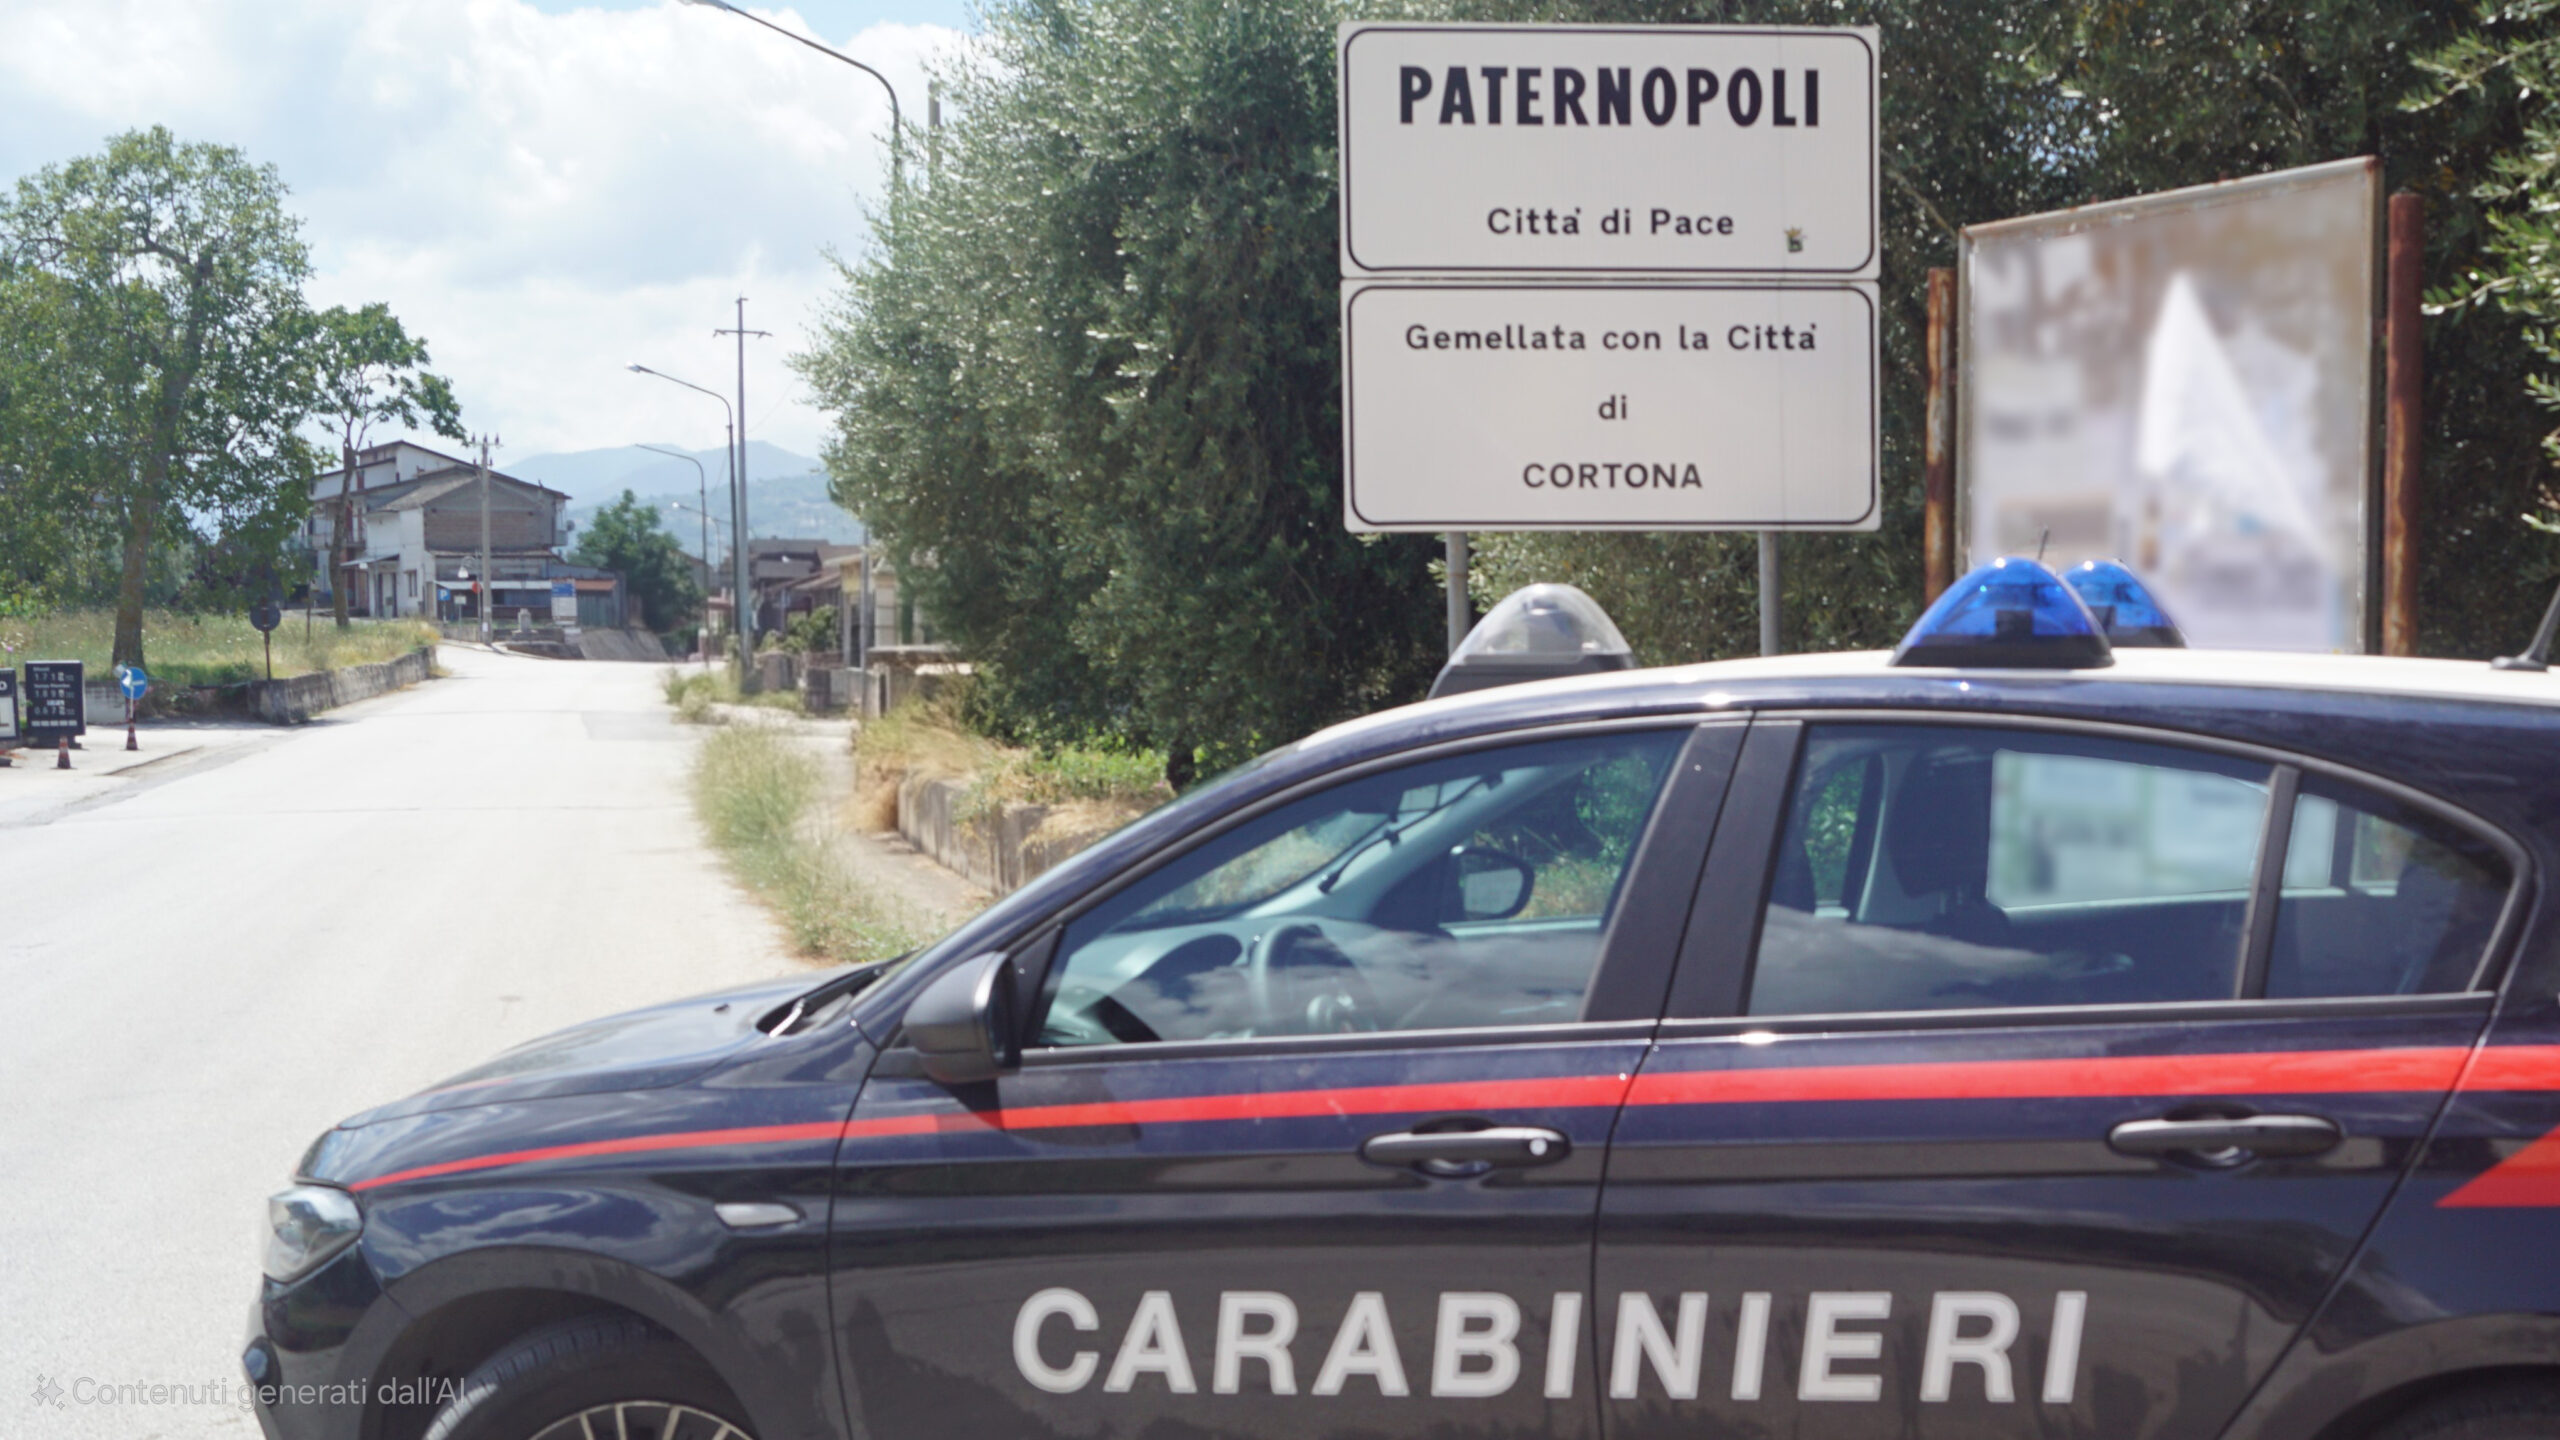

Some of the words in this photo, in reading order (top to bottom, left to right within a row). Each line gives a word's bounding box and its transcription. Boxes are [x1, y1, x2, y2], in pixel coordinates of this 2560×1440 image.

[1399, 65, 1819, 128] PATERNOPOLI
[1600, 207, 1632, 236] di
[1650, 207, 1735, 236] Pace
[1405, 324, 1586, 351] Gemellata
[1602, 331, 1662, 351] con
[1679, 325, 1710, 351] la
[1597, 394, 1628, 421] di
[1522, 463, 1703, 490] CORTONA
[1012, 1287, 2088, 1405] CARABINIERI
